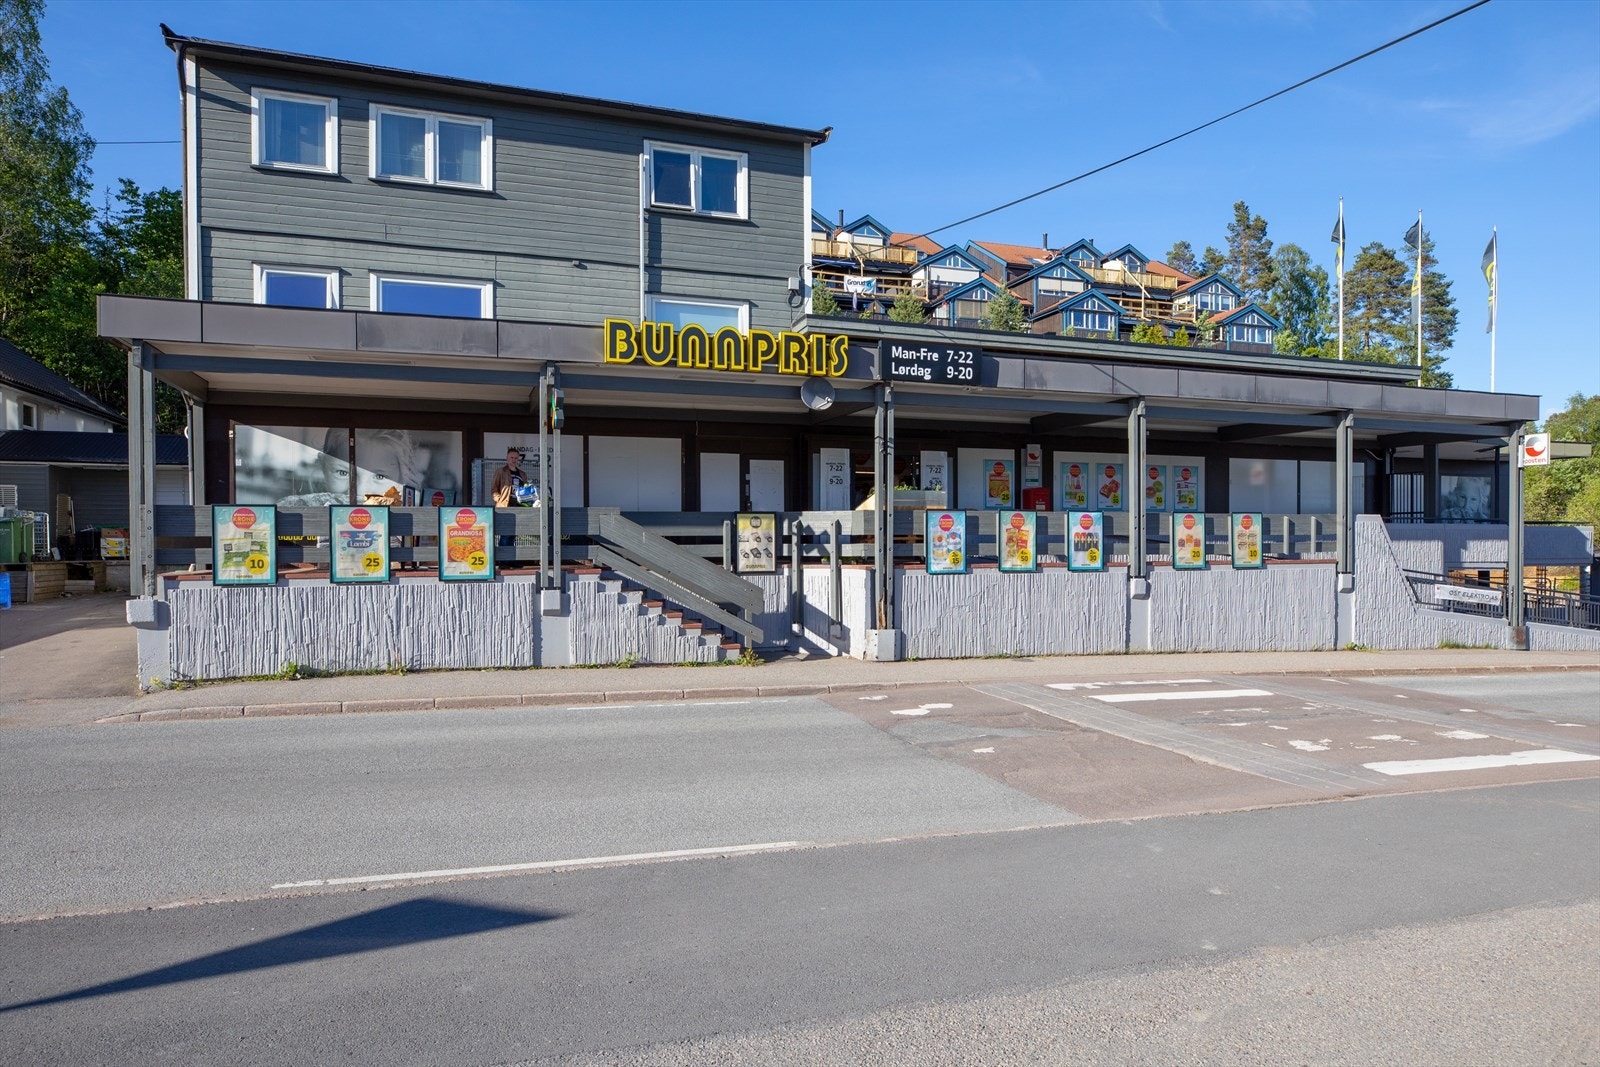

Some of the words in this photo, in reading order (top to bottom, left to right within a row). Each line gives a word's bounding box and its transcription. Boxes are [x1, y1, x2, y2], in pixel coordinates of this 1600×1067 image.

[604, 318, 848, 377] BUNNPRIS
[891, 346, 939, 361] Man-Fre
[946, 350, 973, 364] 7-22
[891, 362, 931, 380] Lørdag
[946, 366, 973, 380] 9-20
[250, 559, 265, 569] 10
[366, 558, 380, 567] 25
[471, 556, 485, 566] 25
